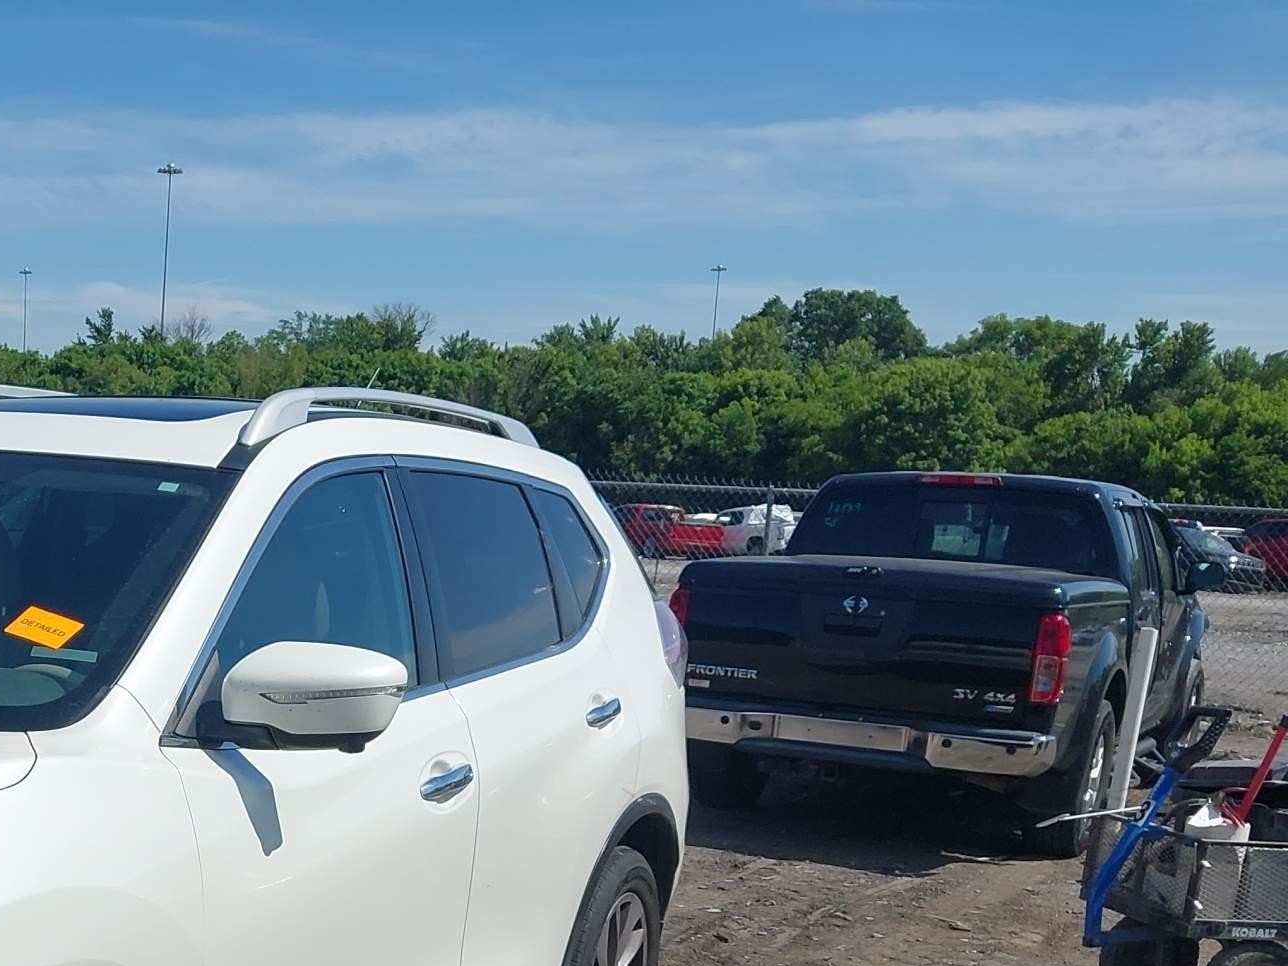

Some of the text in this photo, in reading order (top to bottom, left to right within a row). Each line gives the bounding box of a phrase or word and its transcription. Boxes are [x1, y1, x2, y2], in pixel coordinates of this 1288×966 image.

[20, 618, 66, 637] DETAILED
[686, 663, 758, 680] FRONTIER
[952, 688, 979, 700] SV
[1231, 927, 1278, 938] KOBALT
